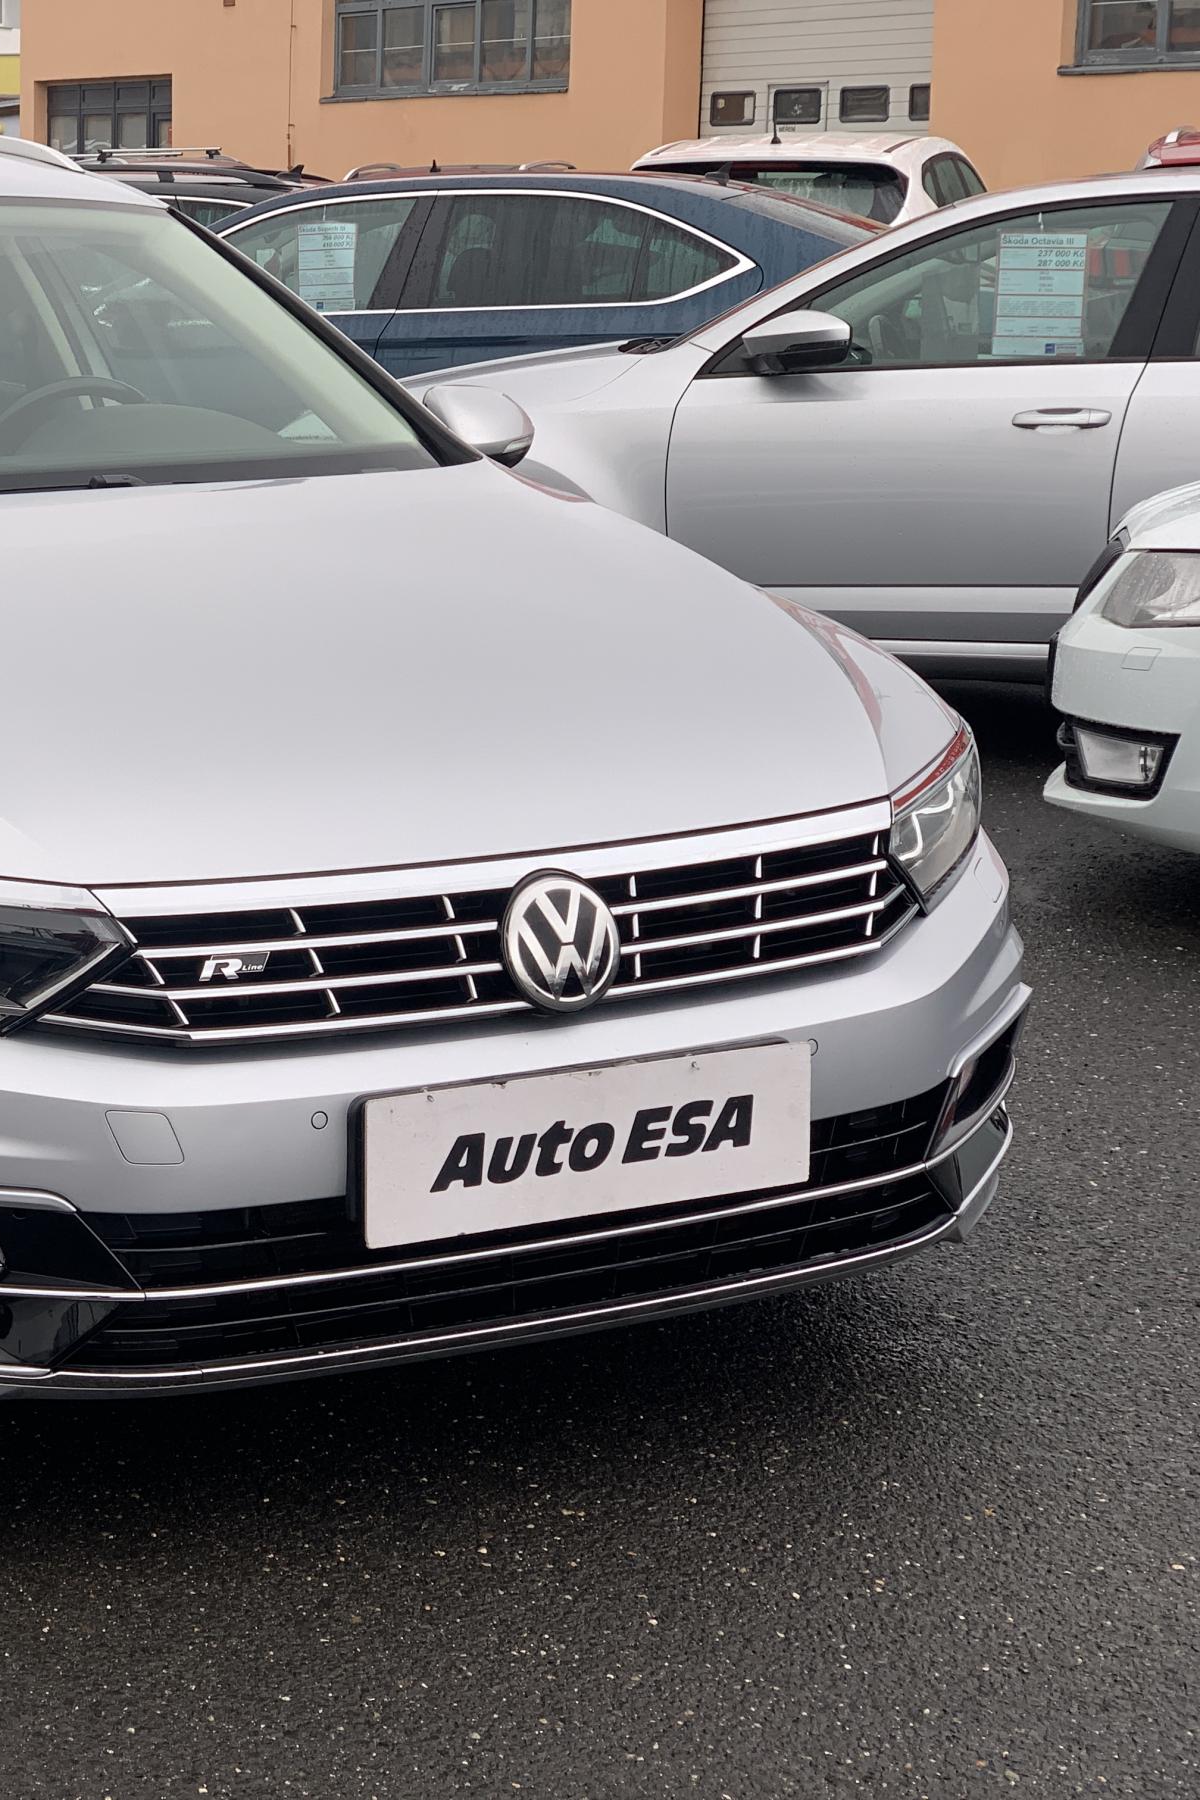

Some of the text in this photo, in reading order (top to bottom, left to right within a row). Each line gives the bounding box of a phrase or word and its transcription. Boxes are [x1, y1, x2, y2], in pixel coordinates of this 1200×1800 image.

[1002, 234, 1074, 245] Škoda Octavia III
[1037, 249, 1053, 257] 237
[1055, 249, 1071, 257] 000
[1037, 259, 1053, 267] 287
[1055, 259, 1071, 267] 000
[429, 1093, 754, 1193] Auto ESA
